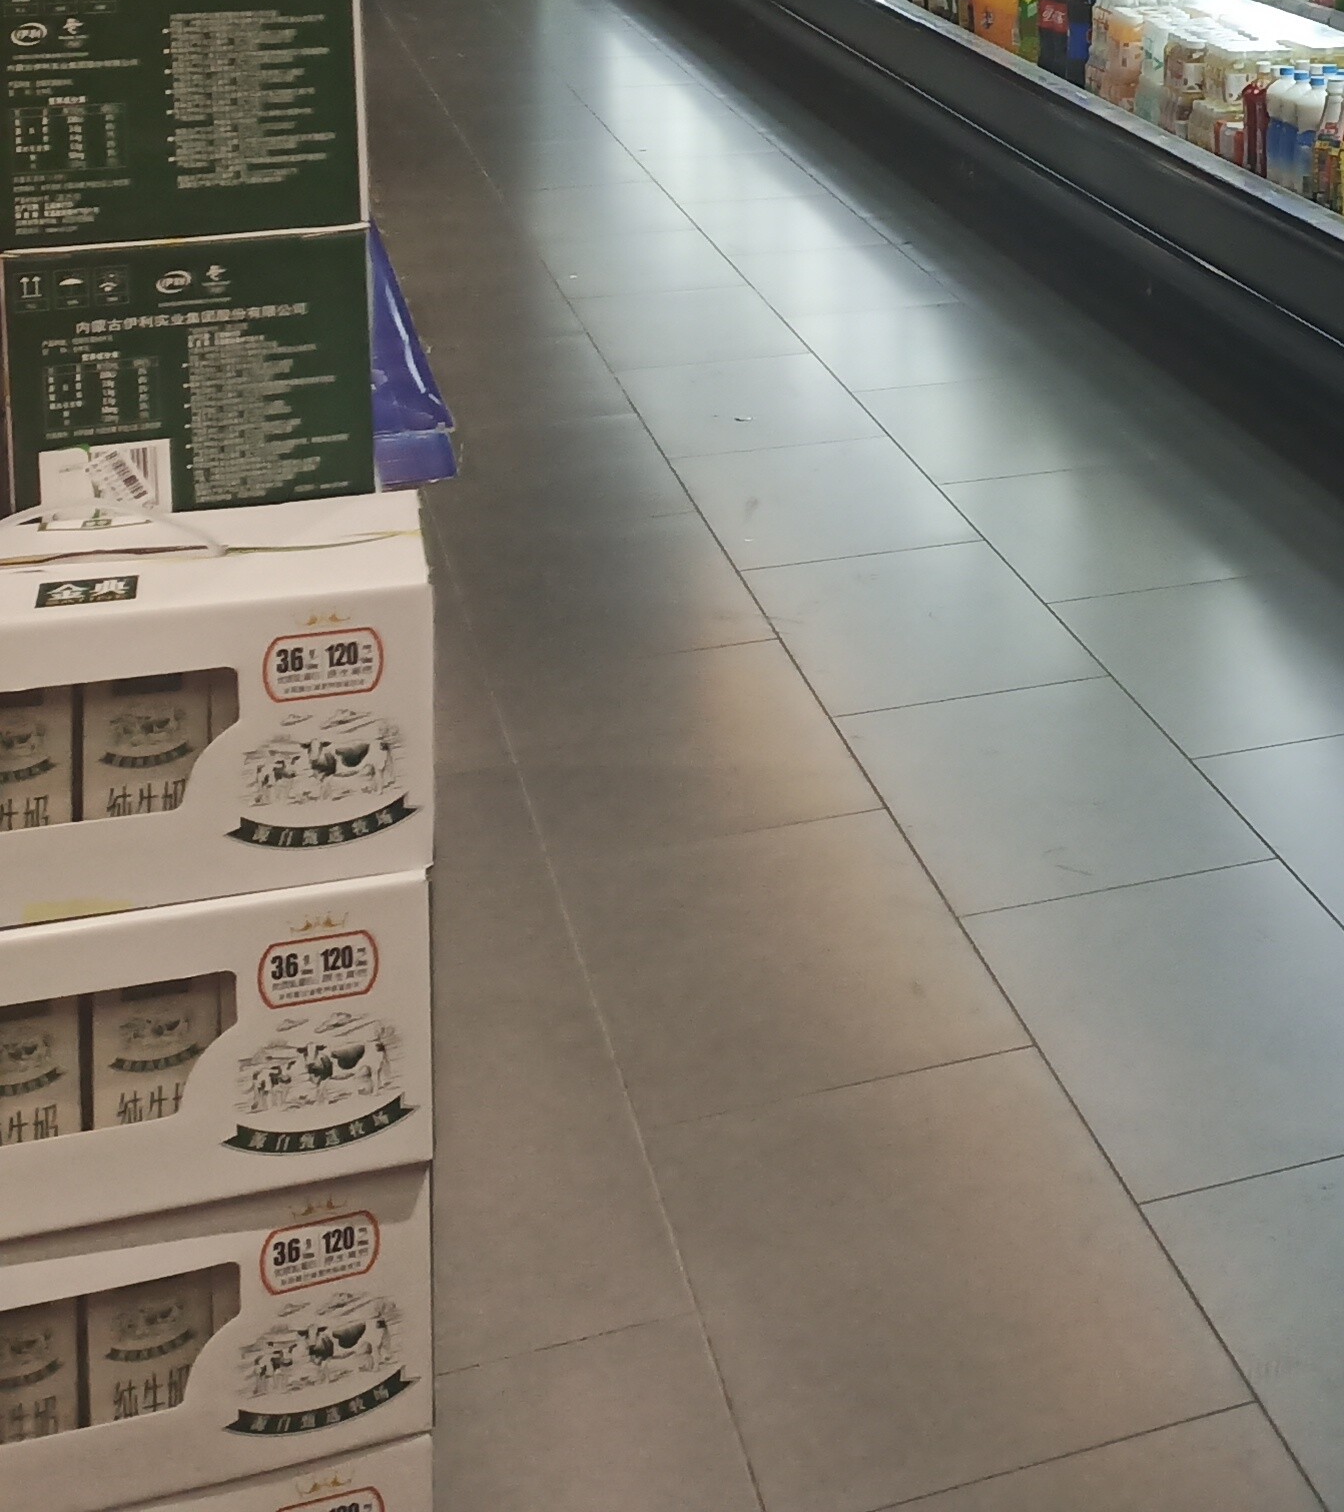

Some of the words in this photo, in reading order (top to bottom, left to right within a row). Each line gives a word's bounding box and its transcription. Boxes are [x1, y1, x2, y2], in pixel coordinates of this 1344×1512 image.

[46, 577, 130, 601] 金典
[324, 641, 360, 668] 120
[321, 944, 354, 972] 120
[322, 1227, 355, 1254] 120
